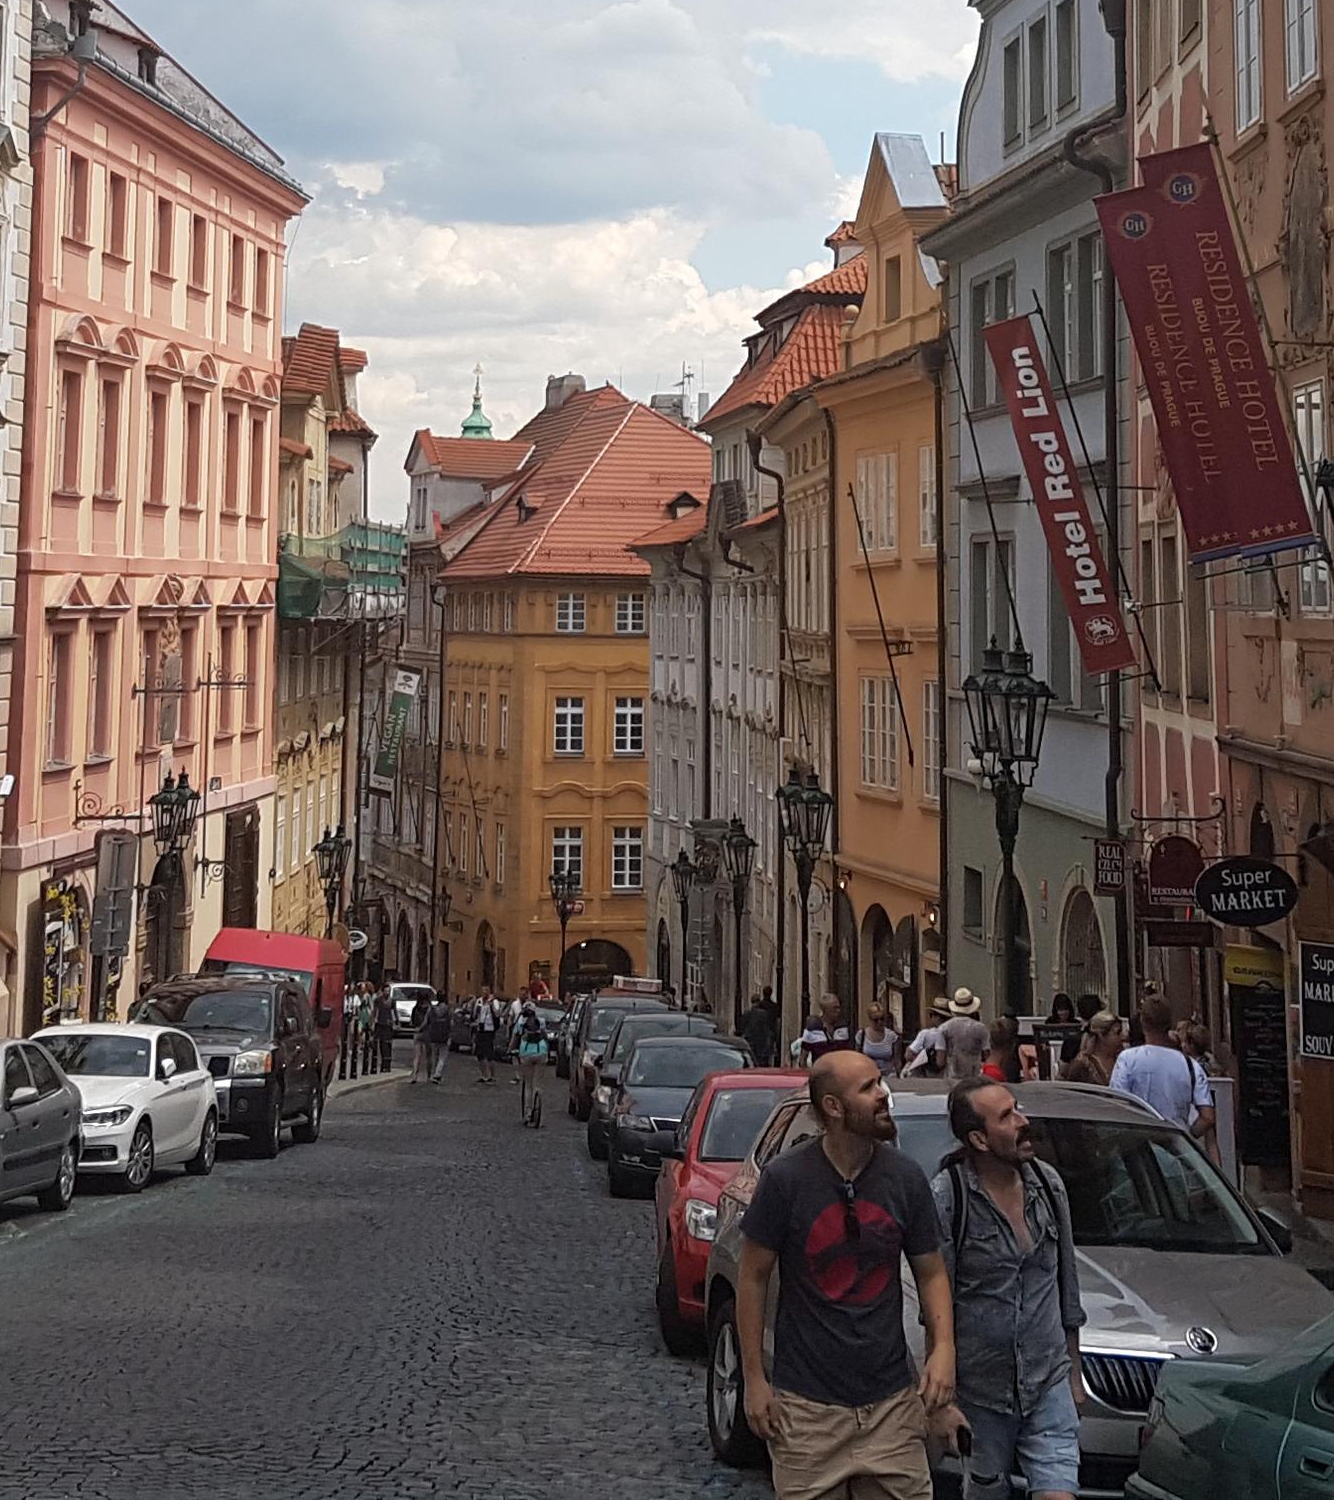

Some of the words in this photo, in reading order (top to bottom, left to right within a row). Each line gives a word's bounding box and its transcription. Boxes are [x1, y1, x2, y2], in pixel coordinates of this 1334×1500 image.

[1172, 182, 1193, 196] GH
[1125, 219, 1145, 233] GH
[1195, 230, 1254, 373] RESIDENCE
[1235, 380, 1279, 472] HOTEL
[1202, 337, 1216, 354] DE
[1011, 346, 1049, 418] Lion
[1146, 263, 1200, 393] RESIDENCE
[1185, 401, 1223, 484] HOTEL
[1154, 362, 1167, 377] DE
[1208, 358, 1231, 409] PRAGUE
[1160, 381, 1181, 428] PRAGUE
[1030, 431, 1074, 500] Red
[1054, 511, 1106, 605] Hotel
[381, 714, 397, 752] VEGAN
[388, 707, 407, 765] RESTAURANT
[1099, 845, 1121, 860] REAL
[1098, 871, 1123, 885] FOOD
[1151, 887, 1195, 896] RESTAURA
[1221, 868, 1273, 889] Super
[1211, 889, 1287, 912] MARKET
